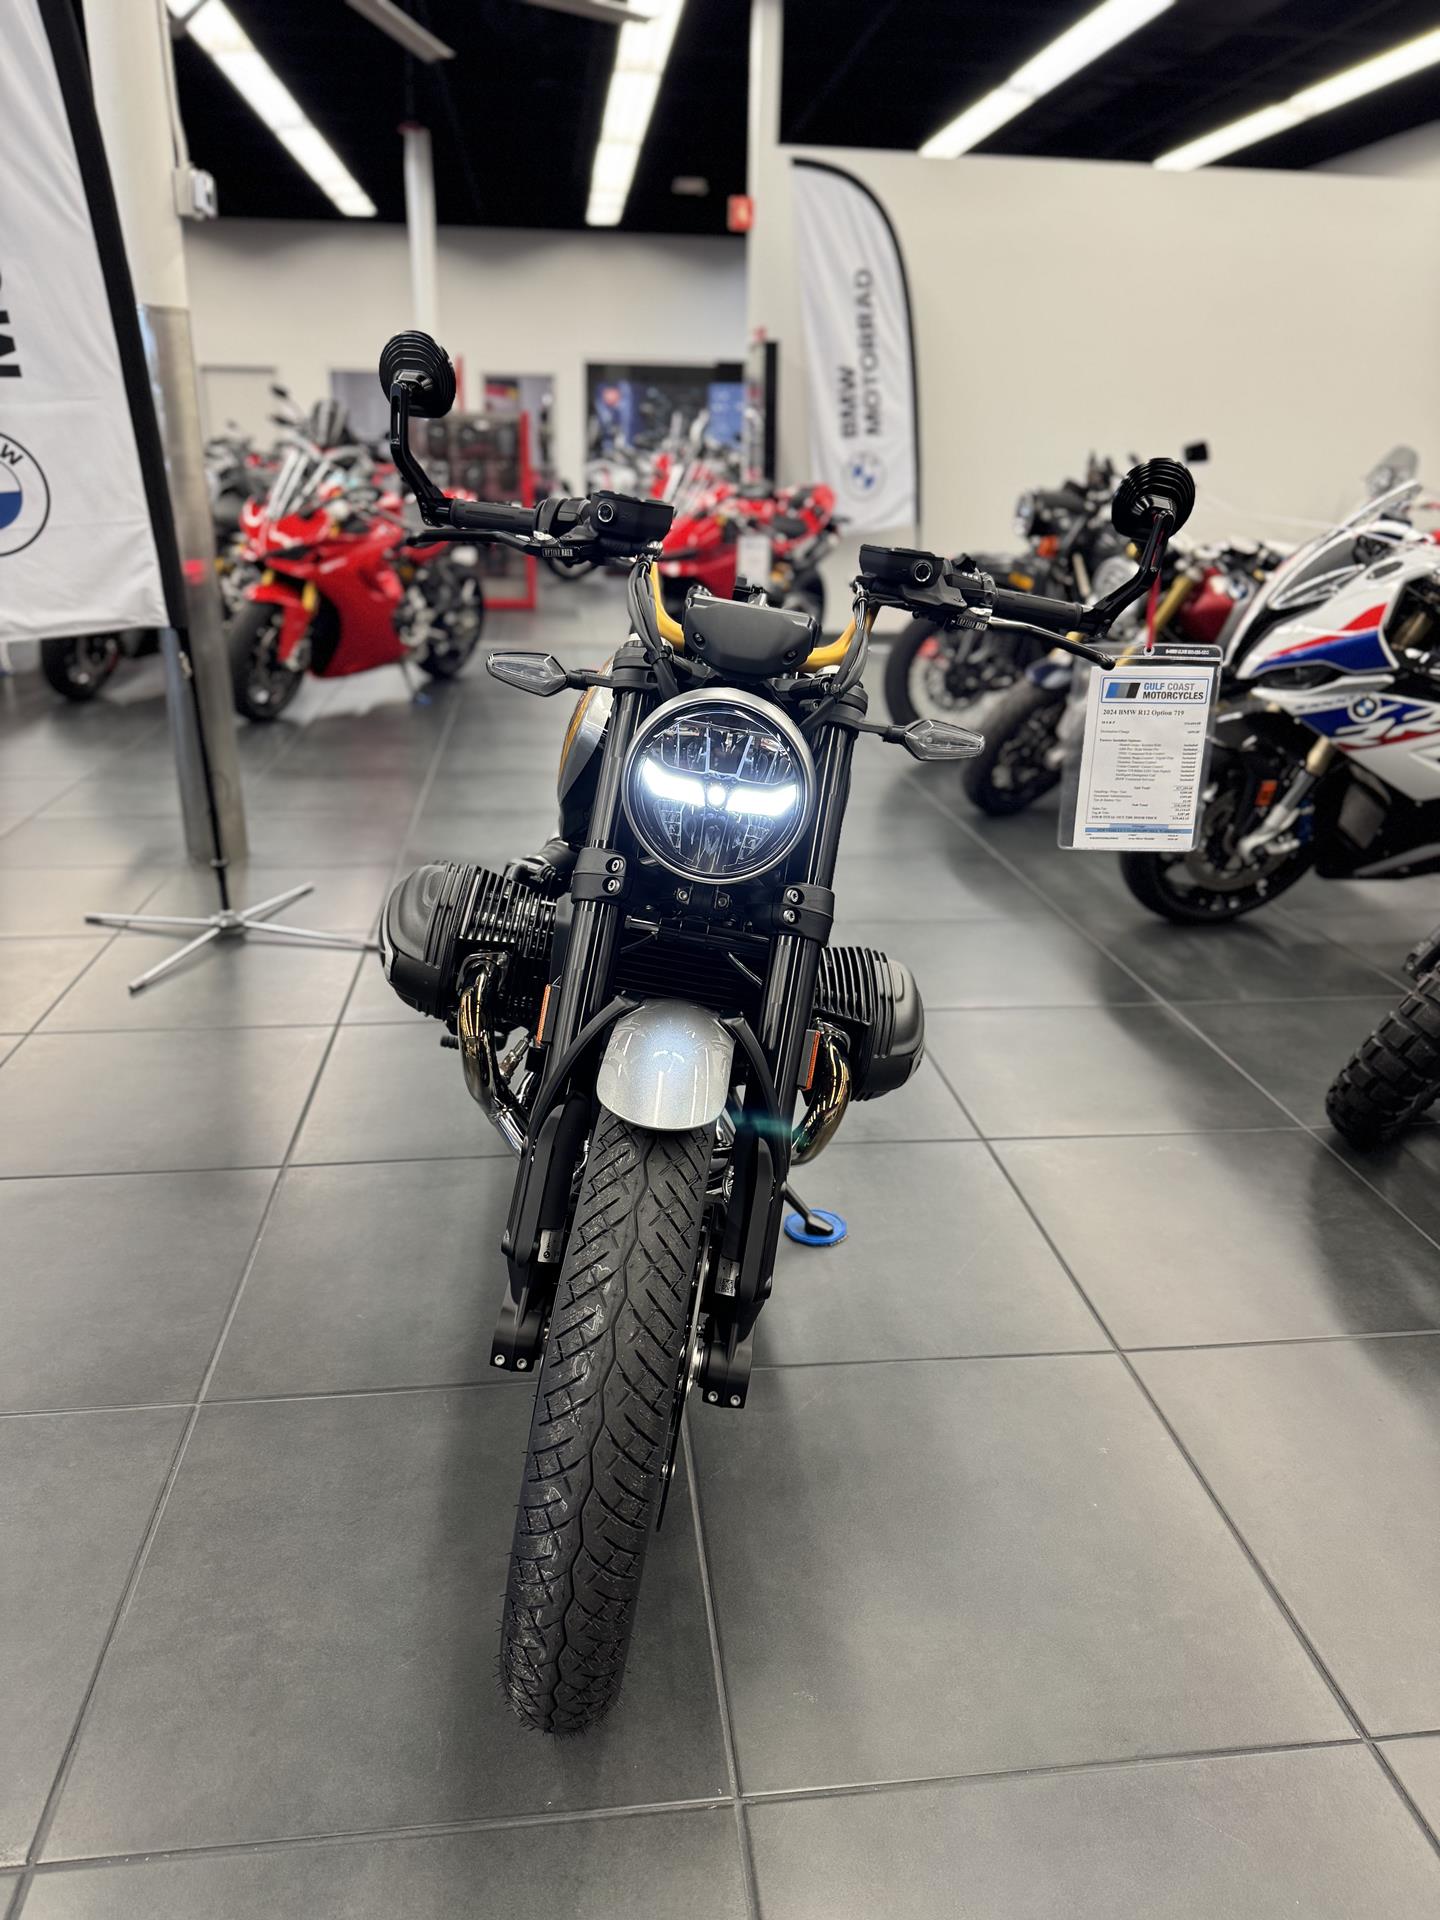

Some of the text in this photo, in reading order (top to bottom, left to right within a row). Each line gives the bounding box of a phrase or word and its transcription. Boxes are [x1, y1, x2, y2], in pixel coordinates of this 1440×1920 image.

[854, 268, 881, 436] MOTORRAD
[839, 366, 858, 439] BMW
[1143, 691, 1204, 700] MOTORCYCLES
[1144, 682, 1195, 691] GULF COAST
